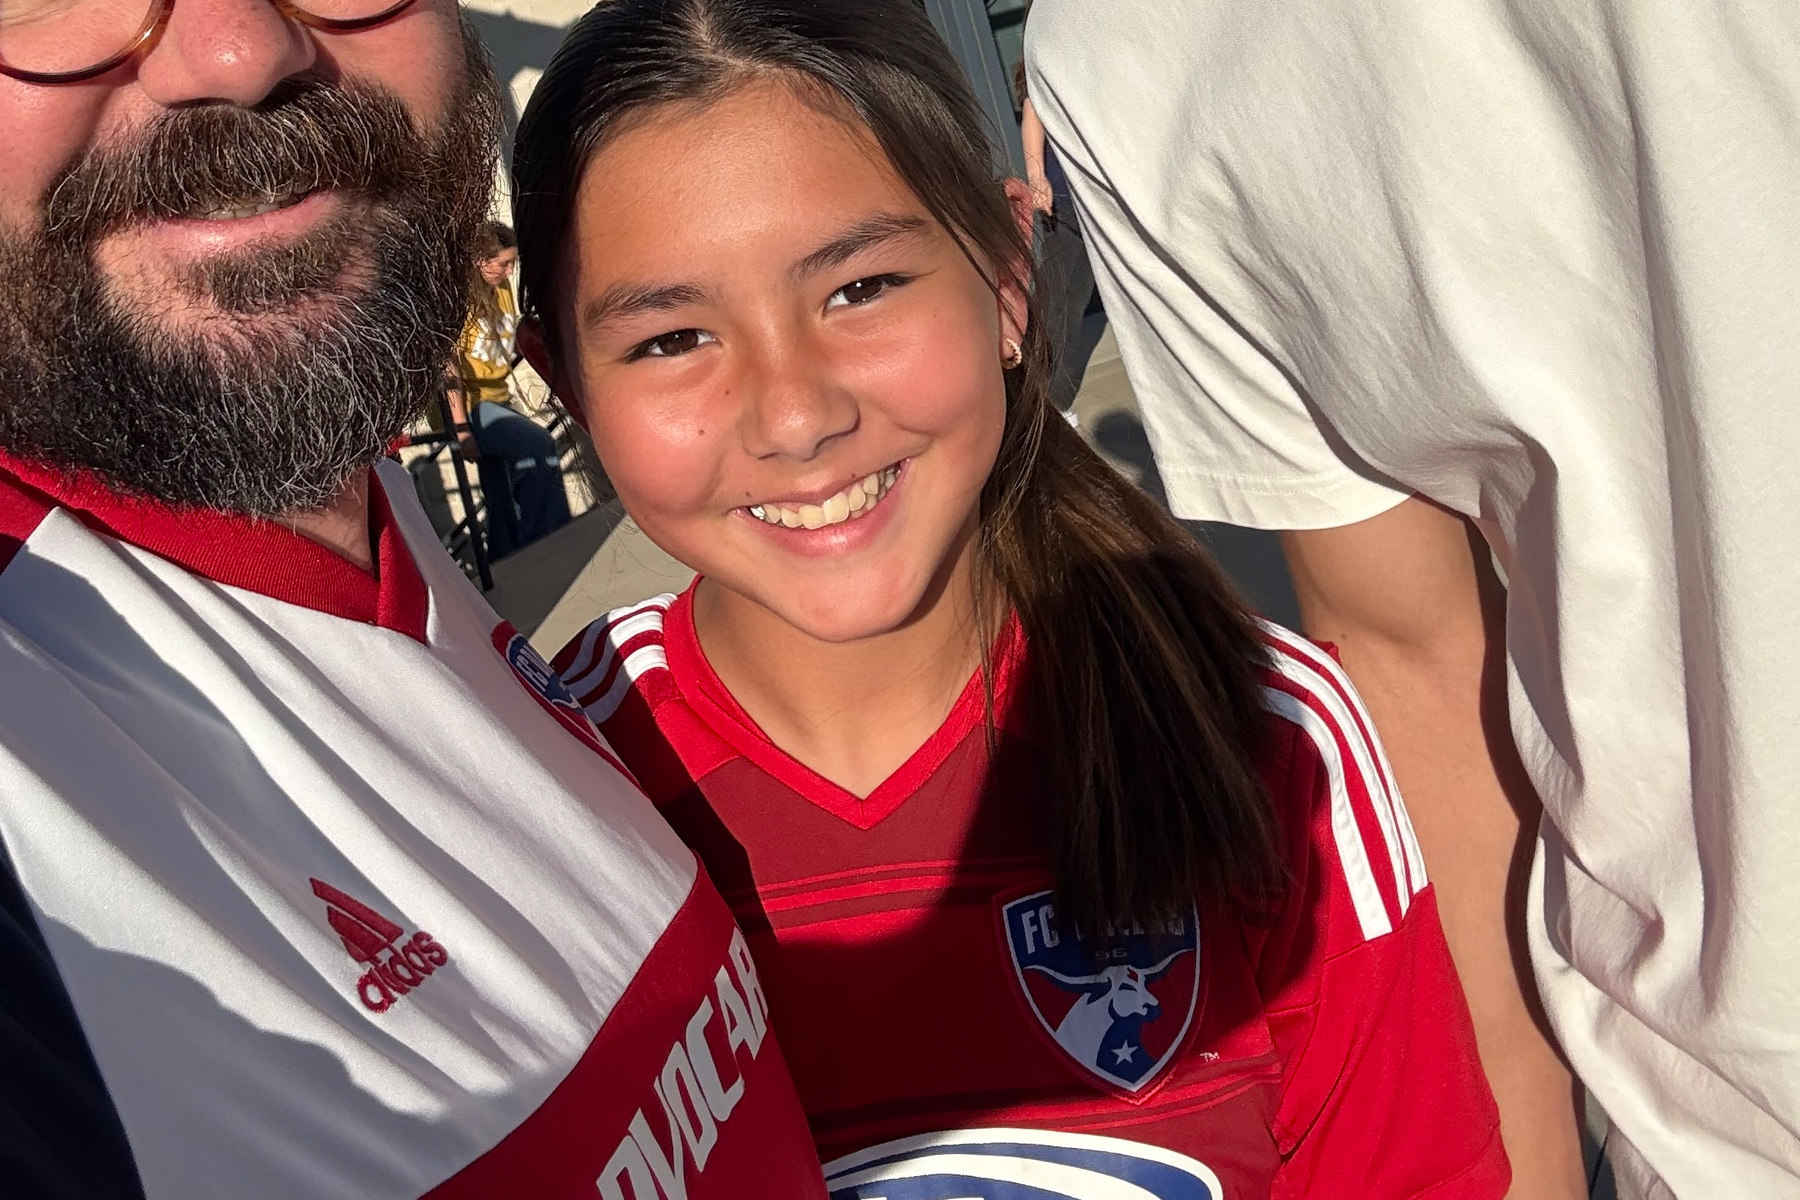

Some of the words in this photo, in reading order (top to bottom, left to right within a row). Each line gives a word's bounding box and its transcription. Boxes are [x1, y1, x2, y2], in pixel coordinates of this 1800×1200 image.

[1021, 904, 1060, 955] FC
[357, 931, 448, 1014] adidas
[1200, 1051, 1220, 1063] TM
